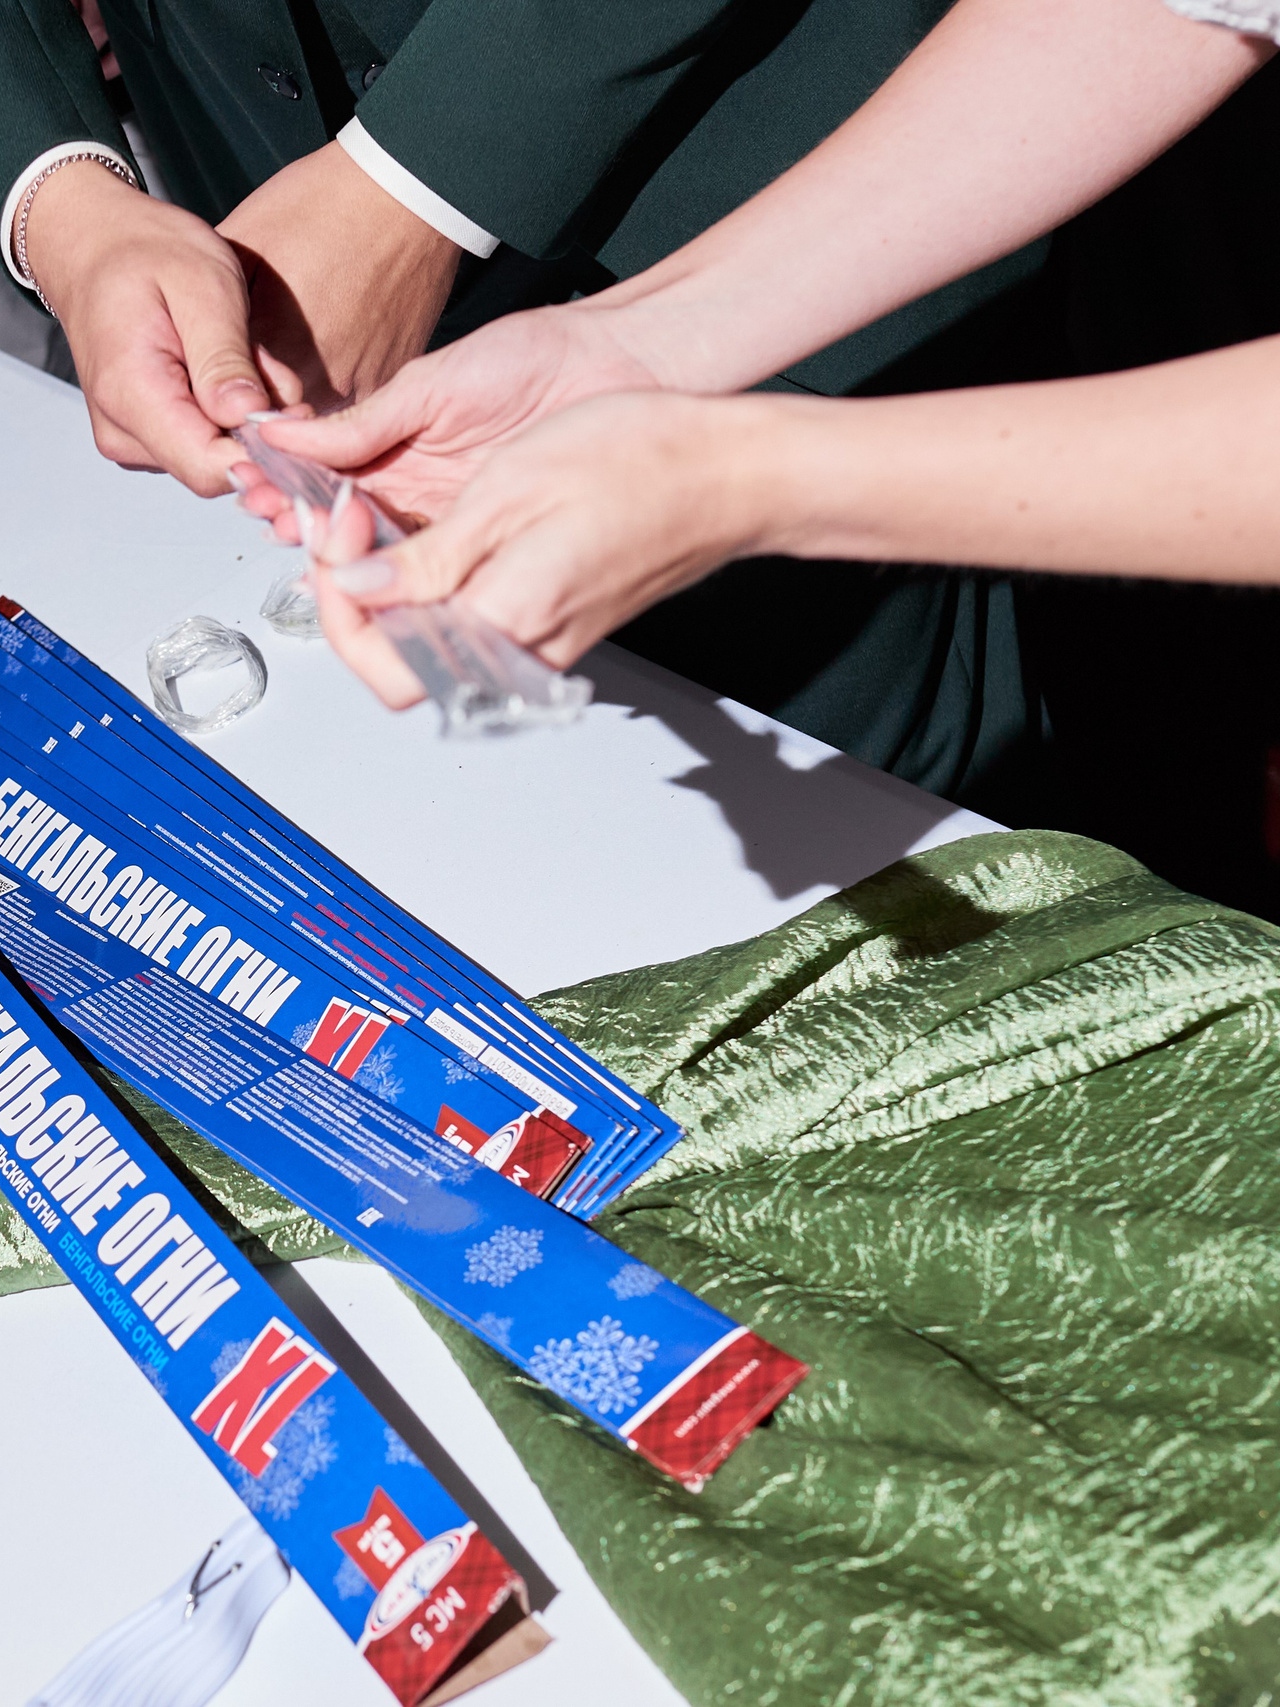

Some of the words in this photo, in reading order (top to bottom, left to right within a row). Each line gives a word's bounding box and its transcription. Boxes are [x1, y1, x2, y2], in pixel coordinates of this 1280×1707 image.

[177, 925, 302, 1028] ОГНИ
[26, 1191, 62, 1235] ОГНИ
[58, 1230, 140, 1336] БЕНГАЛЬСКИЕ
[131, 1324, 170, 1373] ОГНИ
[97, 1191, 241, 1352] ОГНИ
[190, 1316, 338, 1479] XL
[370, 1529, 406, 1570] 5
[409, 1622, 434, 1653] 5
